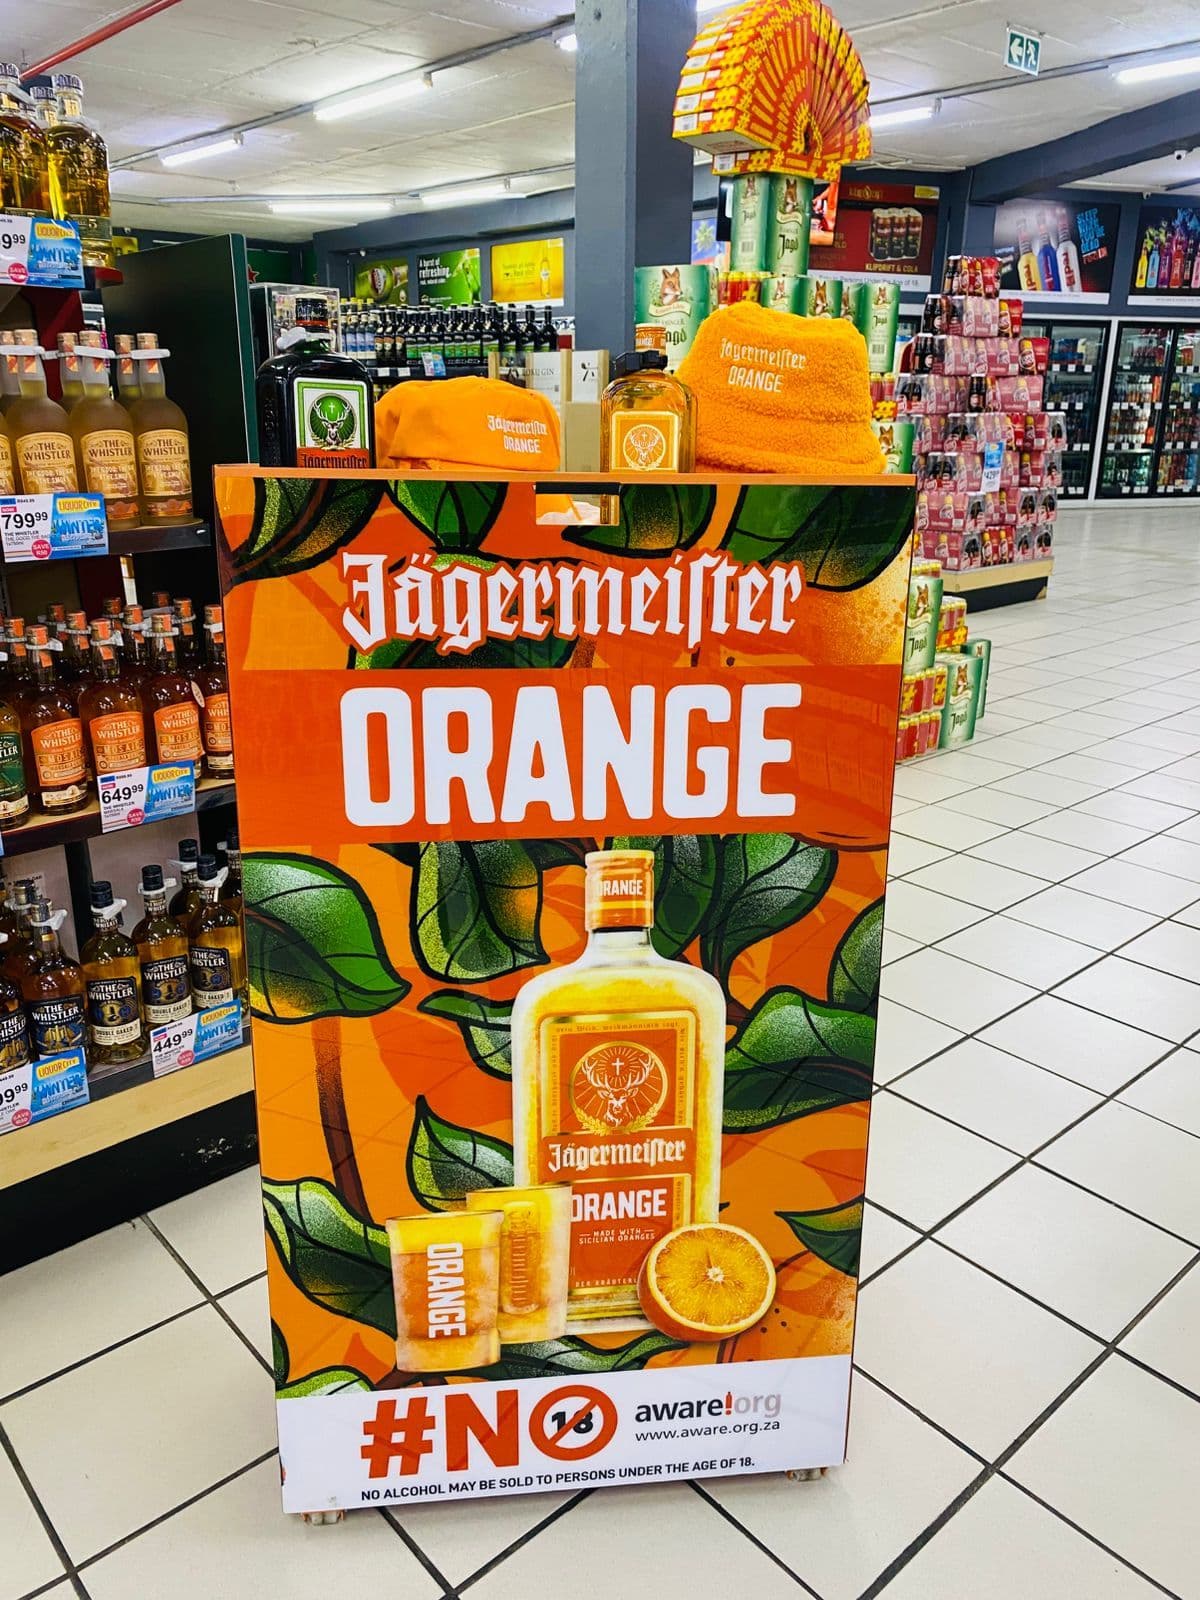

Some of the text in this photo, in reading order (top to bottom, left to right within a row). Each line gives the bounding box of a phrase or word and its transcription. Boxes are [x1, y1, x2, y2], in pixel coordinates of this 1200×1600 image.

[541, 368, 555, 376] GIN
[728, 365, 784, 393] ORANGE
[37, 442, 56, 451] THE
[144, 446, 185, 456] WHISTLER
[503, 434, 541, 454] ORANGE
[23, 450, 72, 461] WHISTLER
[88, 447, 133, 458] WHISTLER
[341, 552, 802, 651] Jägermeister
[112, 720, 128, 730] THE
[340, 683, 802, 826] ORANGE
[159, 964, 174, 973] THE
[89, 986, 134, 1001] WHISTLER
[100, 984, 117, 992] THE
[32, 1006, 79, 1021] WHISTLER
[44, 1004, 63, 1014] THE
[2, 1016, 18, 1029] THE
[39, 1062, 63, 1078] LIQUOR
[548, 1138, 686, 1173] Jägermeister
[570, 1188, 667, 1222] ORANGE
[579, 1233, 655, 1245] SICILIAN ORANGES
[427, 1242, 466, 1339] ORANGE
[635, 1419, 780, 1443] www.aware.org.za
[361, 1457, 755, 1500] NO ALCOHOL MAY BE SOLD TO PERSONS UNDER THE AGE OF 18.
